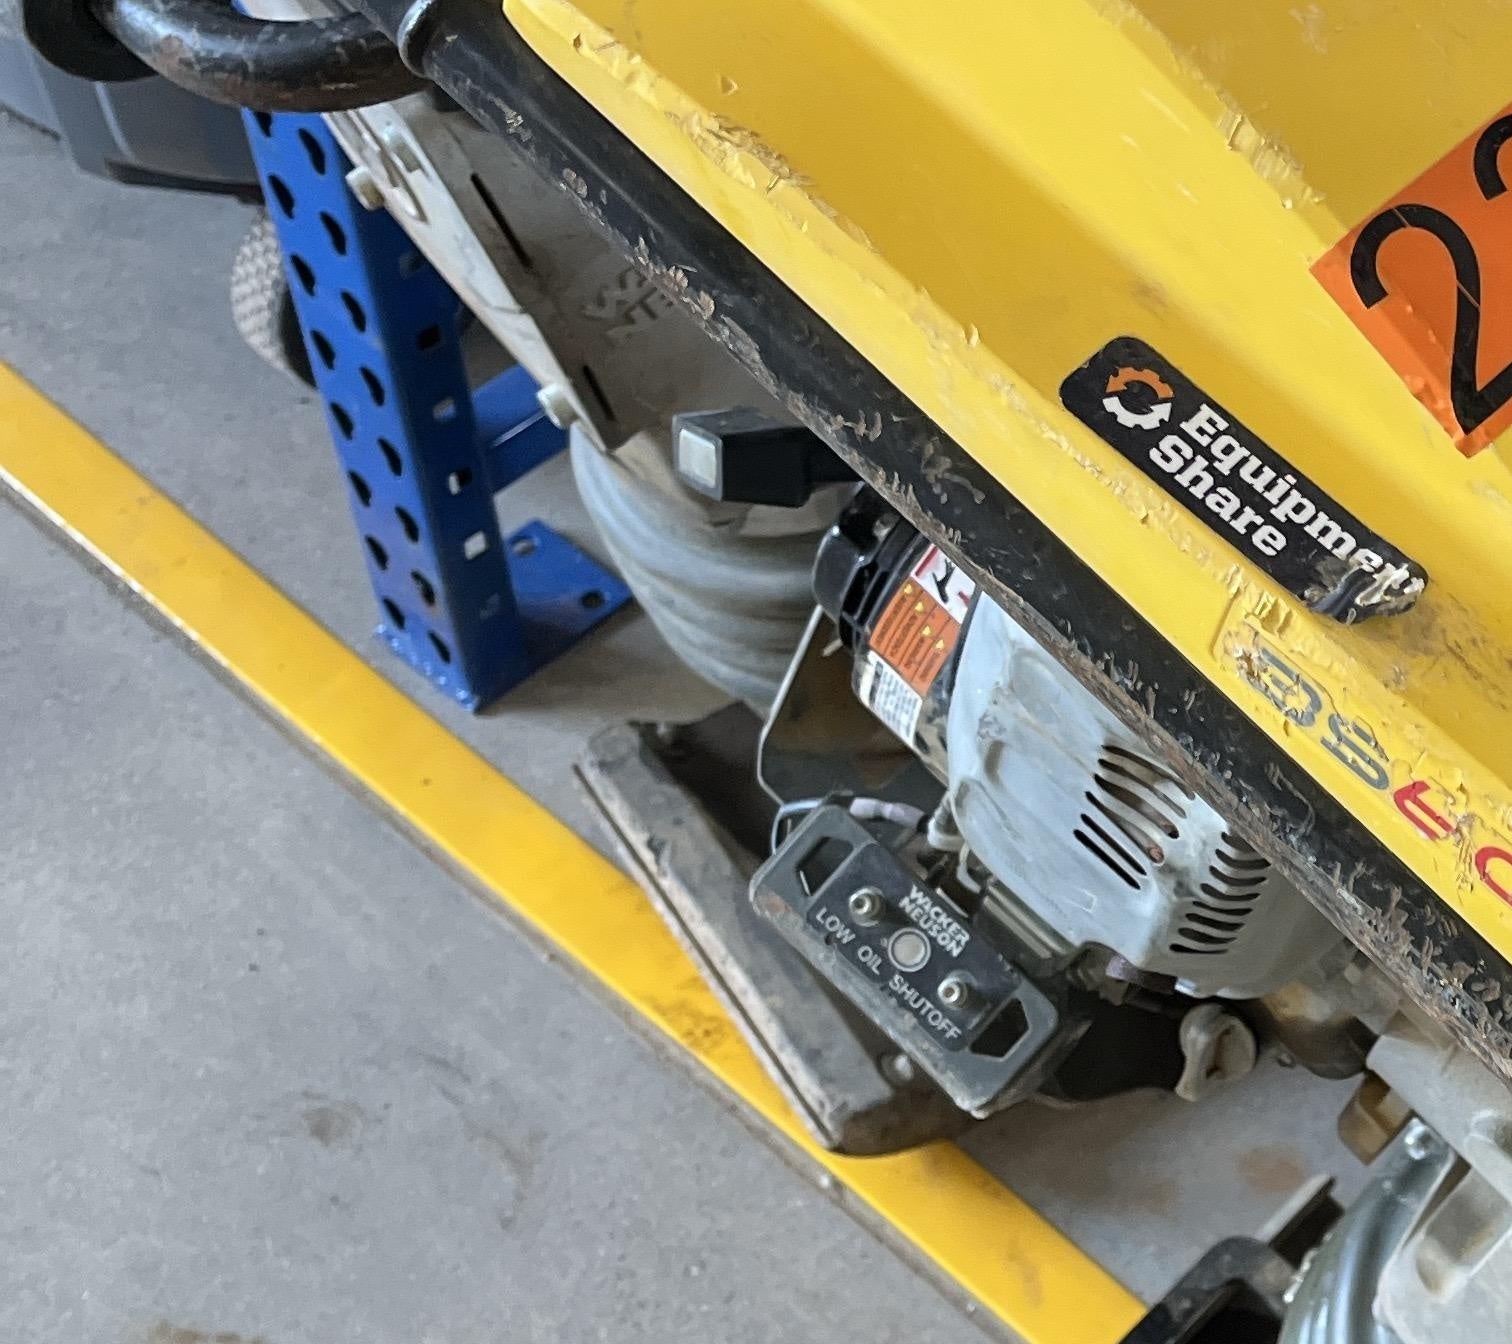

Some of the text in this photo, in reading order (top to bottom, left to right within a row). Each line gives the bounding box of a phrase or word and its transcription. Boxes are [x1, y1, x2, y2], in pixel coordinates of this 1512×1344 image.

[1149, 433, 1288, 558] Share
[895, 895, 965, 958] NEUSON
[903, 884, 973, 947] WACKER
[813, 906, 964, 1043] LOW OIL SHUTOFF
